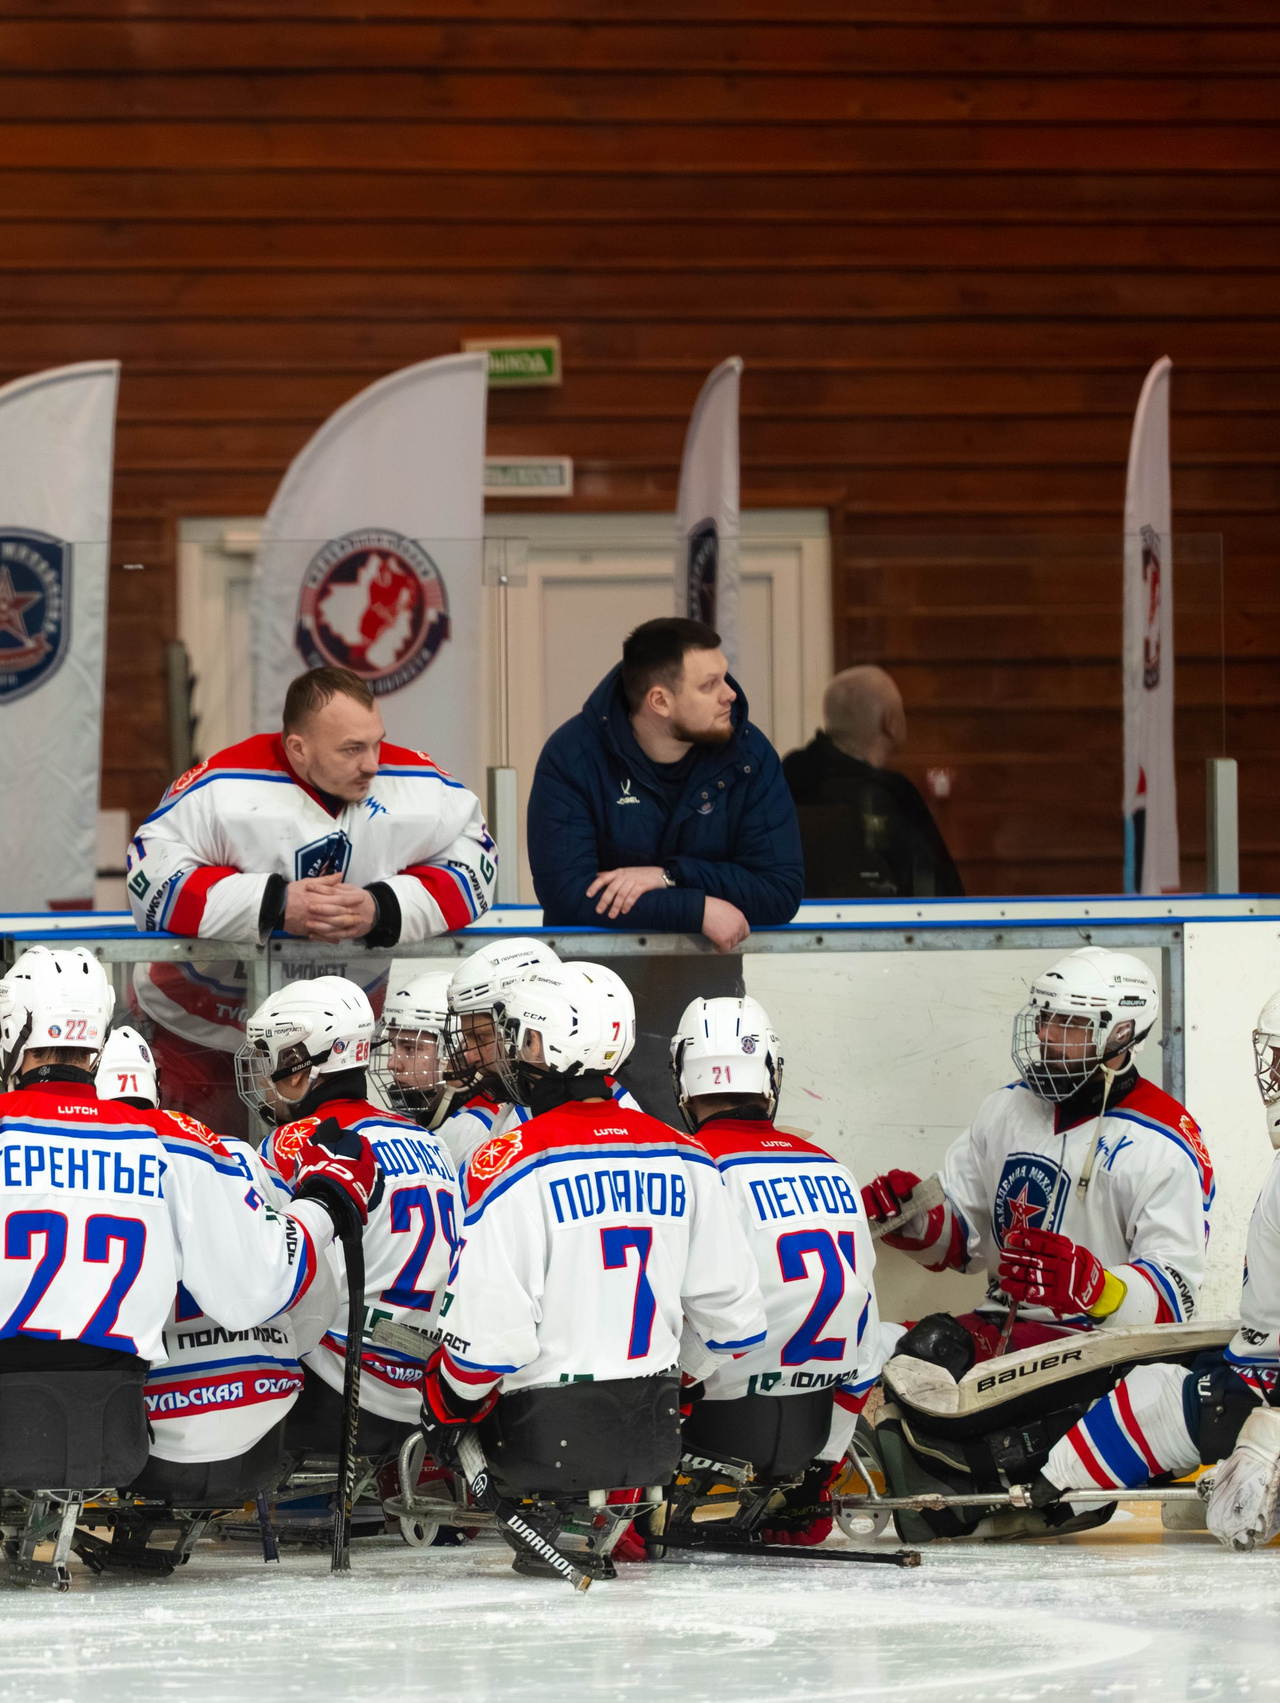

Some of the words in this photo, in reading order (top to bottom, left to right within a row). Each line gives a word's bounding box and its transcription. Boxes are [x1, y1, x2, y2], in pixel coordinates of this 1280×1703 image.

[523, 1011, 547, 1021] CCM
[64, 1019, 88, 1040] 22
[612, 1022, 621, 1041] 7
[356, 1041, 370, 1061] 28
[117, 1074, 138, 1092] 71
[712, 1065, 731, 1084] 21
[58, 1106, 98, 1115] LUTCH
[593, 1128, 629, 1136] LUTCH
[761, 1140, 793, 1148] LUTCH
[549, 1169, 687, 1223] ПОЛЯКОВ
[749, 1174, 858, 1221] ПЕТРОВ
[599, 1225, 656, 1361] 7
[976, 1349, 1083, 1393] BAUER
[144, 1381, 245, 1413] УЛЬСКАЯ
[506, 1514, 574, 1580] WARRIOR
